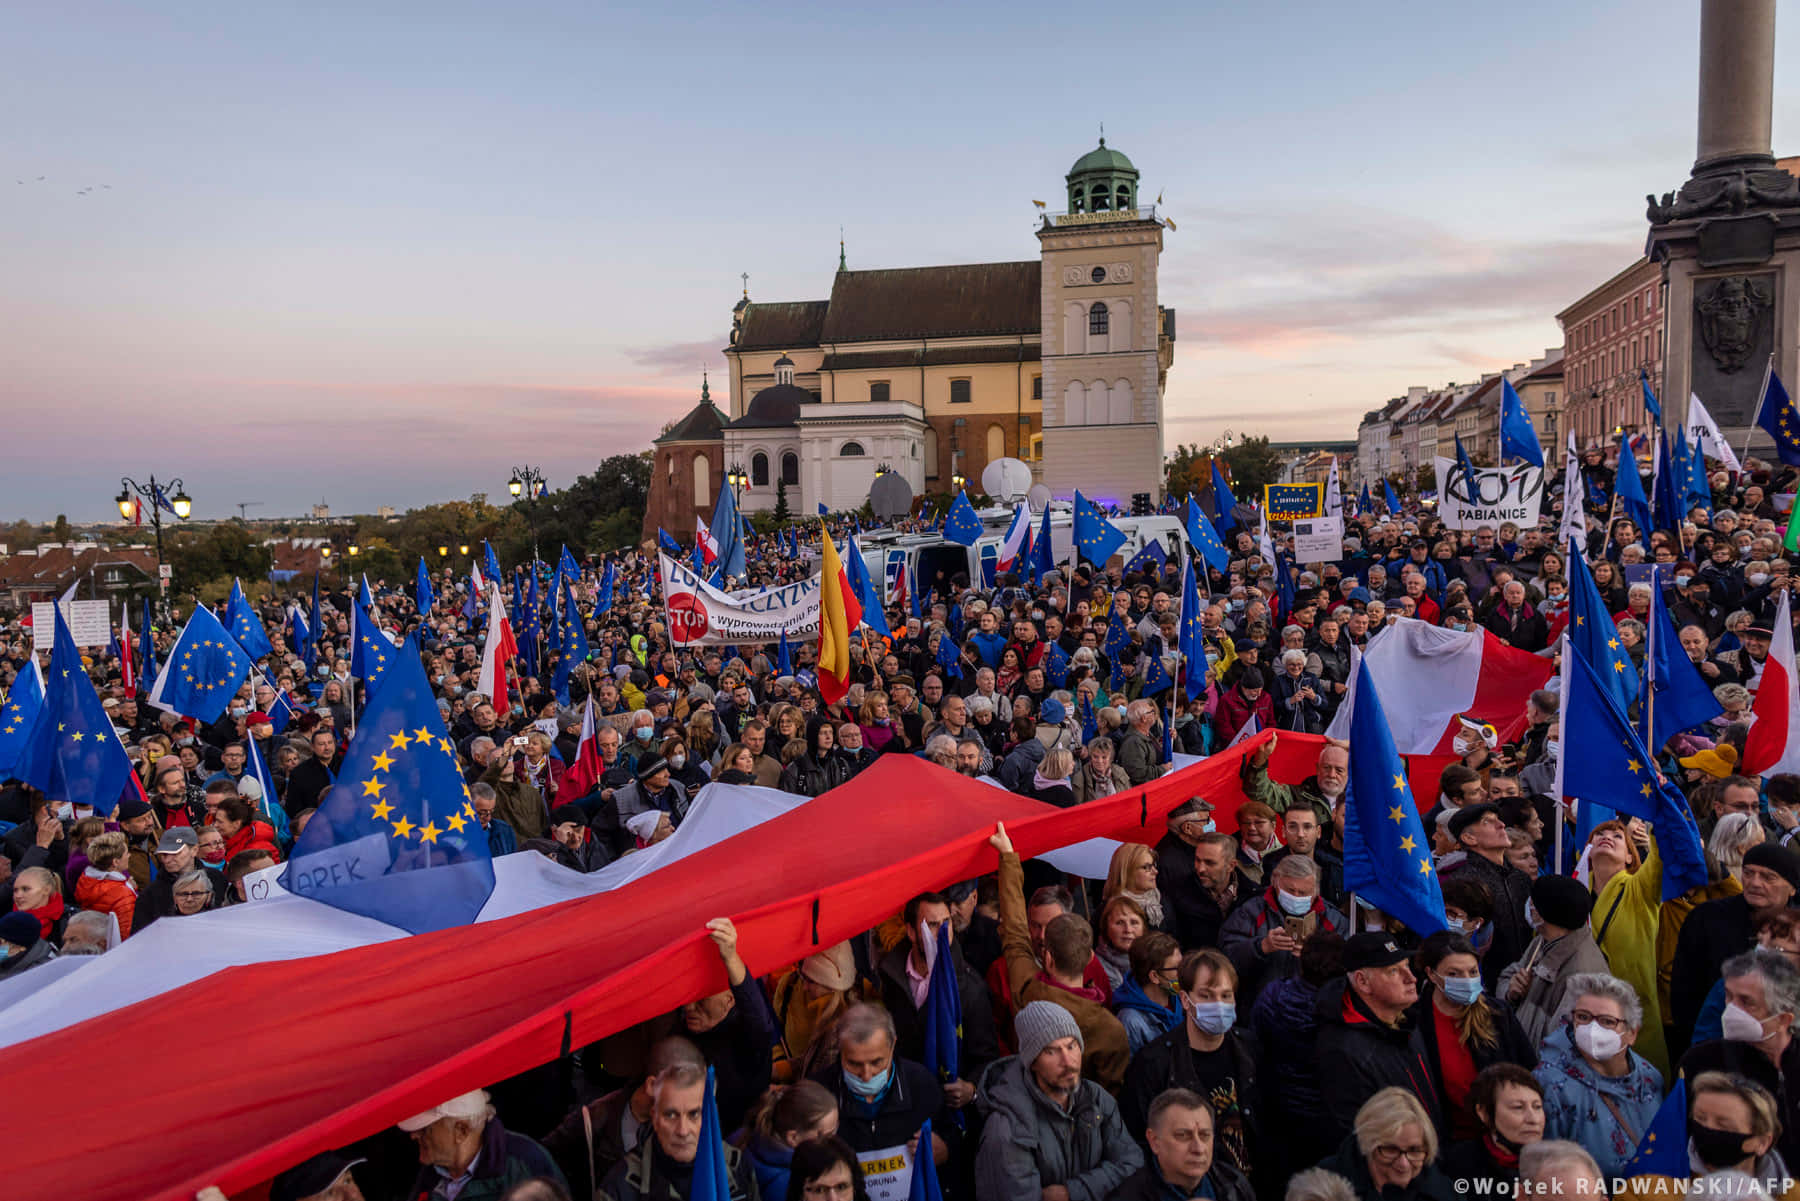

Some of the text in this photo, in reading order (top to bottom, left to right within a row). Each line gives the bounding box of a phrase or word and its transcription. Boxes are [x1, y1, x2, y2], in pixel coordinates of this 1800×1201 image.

[1457, 508, 1527, 521] PABIANICE
[807, 604, 819, 616] Po
[668, 608, 705, 628] STOP
[866, 1156, 905, 1174] RNEK
[867, 1175, 898, 1188] ORUNIA
